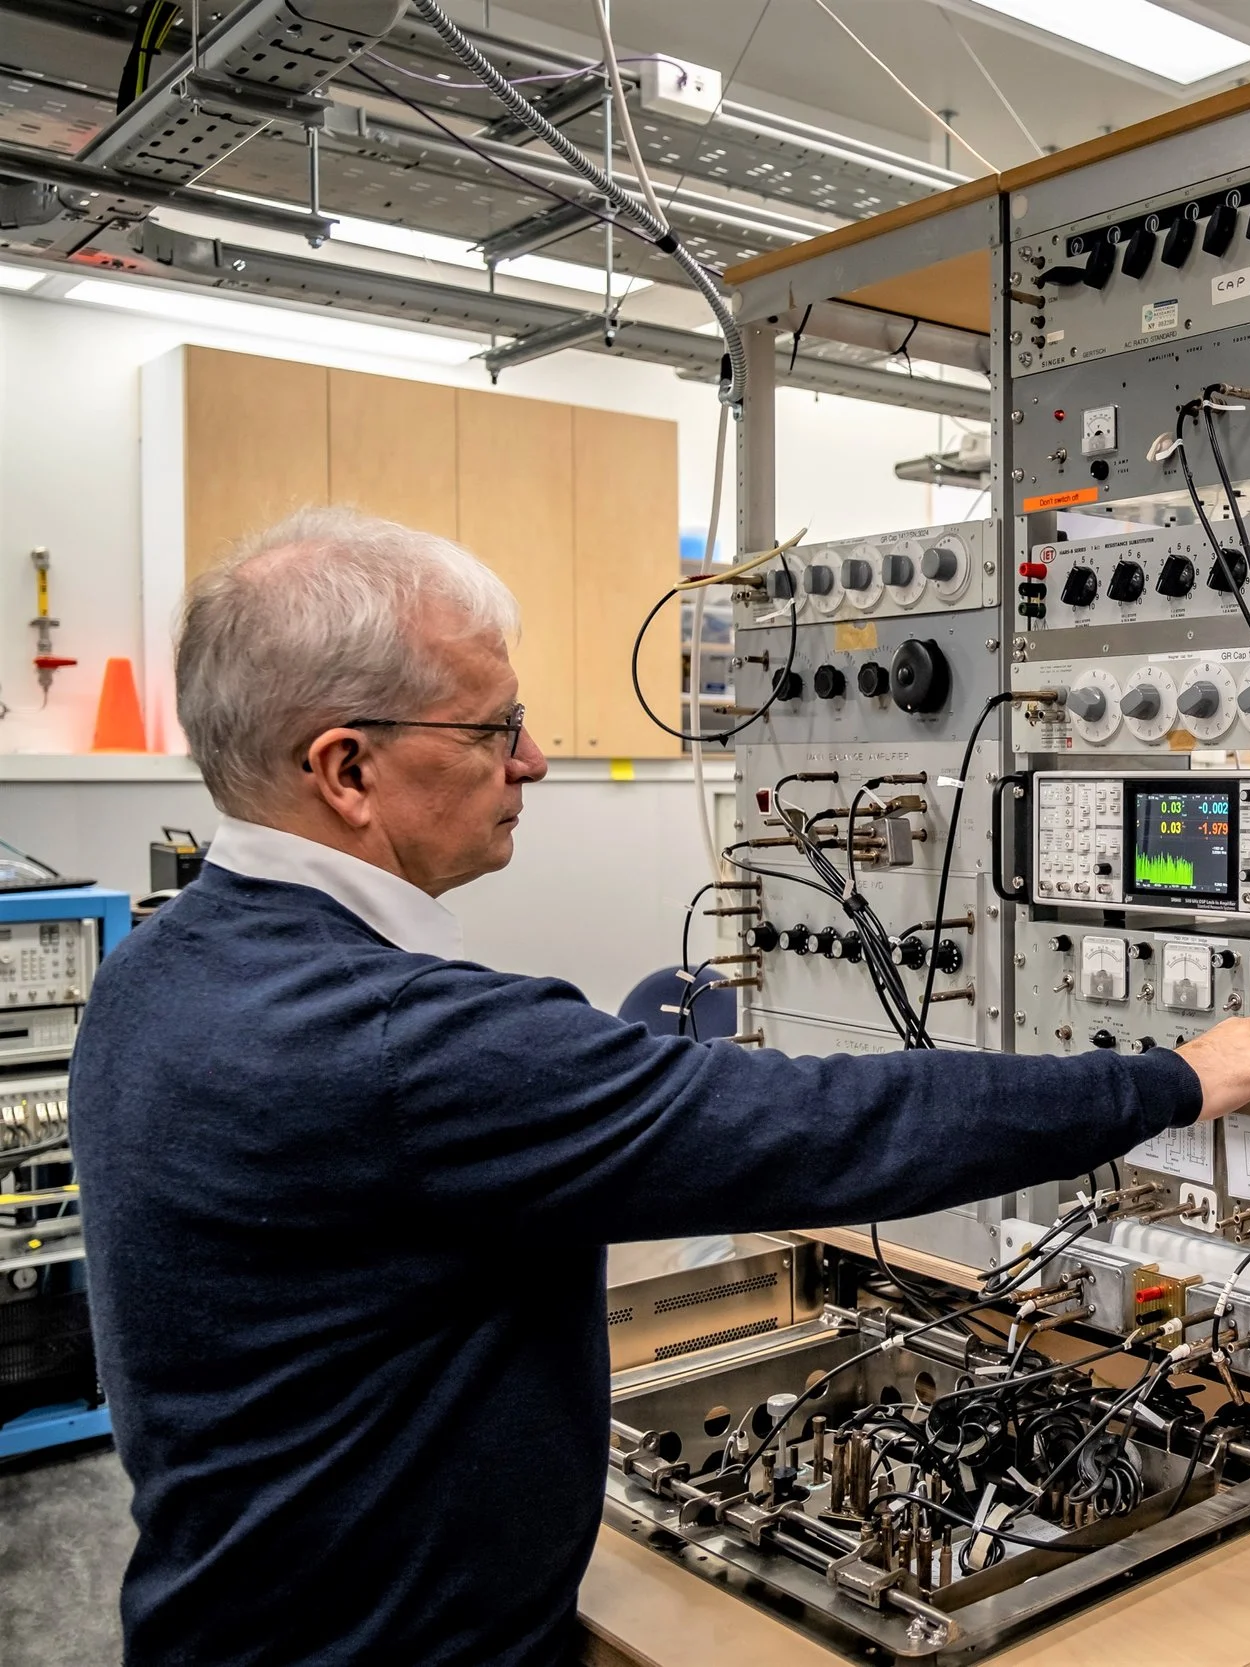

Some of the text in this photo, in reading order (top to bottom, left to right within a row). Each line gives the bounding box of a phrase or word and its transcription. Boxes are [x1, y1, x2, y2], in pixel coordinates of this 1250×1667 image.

[1217, 276, 1246, 291] CAP
[1133, 338, 1149, 346] RATIO
[1150, 331, 1178, 342] STANDARD
[1041, 357, 1066, 368] SINGER
[1043, 549, 1055, 561] IET
[1221, 652, 1232, 660] GR
[1233, 651, 1247, 660] Cap
[829, 753, 863, 761] BALANCE
[869, 753, 909, 761] AMPLIFIER
[1161, 801, 1229, 814] 0.03 -0.002
[1161, 821, 1229, 835] 0.03 -1.979
[845, 1040, 869, 1051] STAGE
